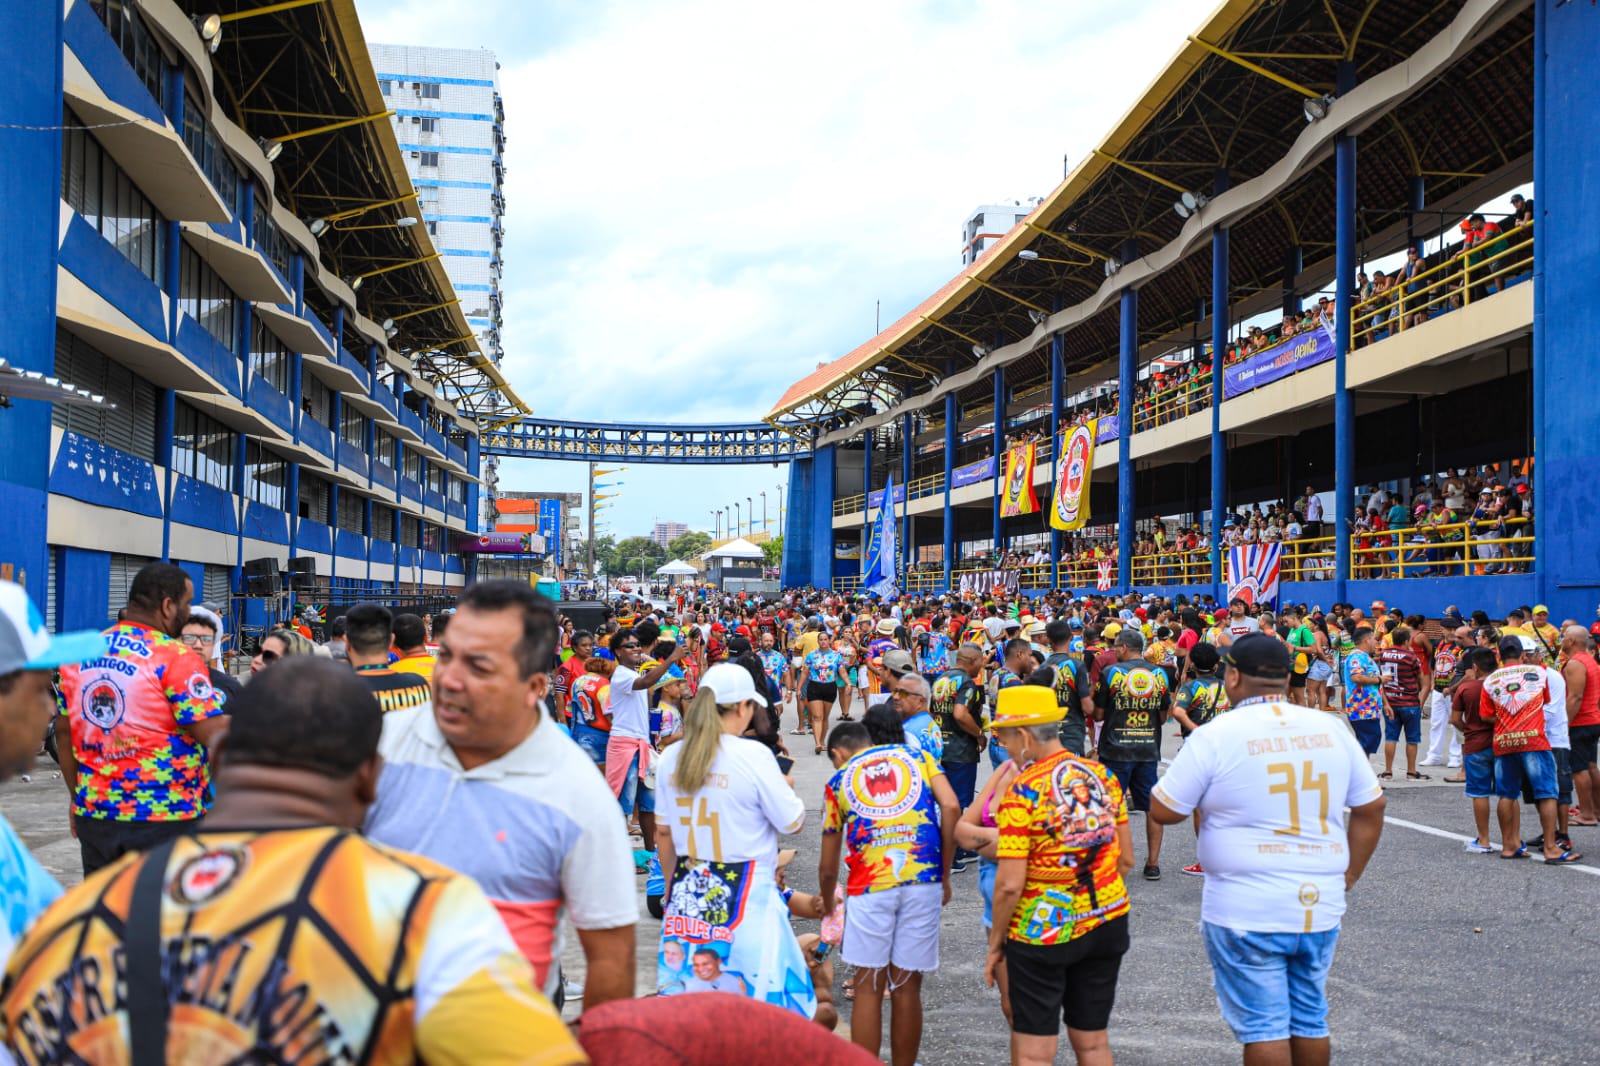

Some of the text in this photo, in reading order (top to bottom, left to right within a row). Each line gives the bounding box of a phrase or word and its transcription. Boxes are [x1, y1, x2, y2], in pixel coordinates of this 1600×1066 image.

[1295, 336, 1317, 362] gente
[117, 636, 150, 657] DOS
[1126, 711, 1149, 727] 89
[1500, 737, 1528, 748] 2023
[1267, 760, 1329, 836] 34
[872, 824, 912, 837] BATERIA
[871, 834, 917, 849] FURACÃO
[664, 916, 711, 940] EQUIPE
